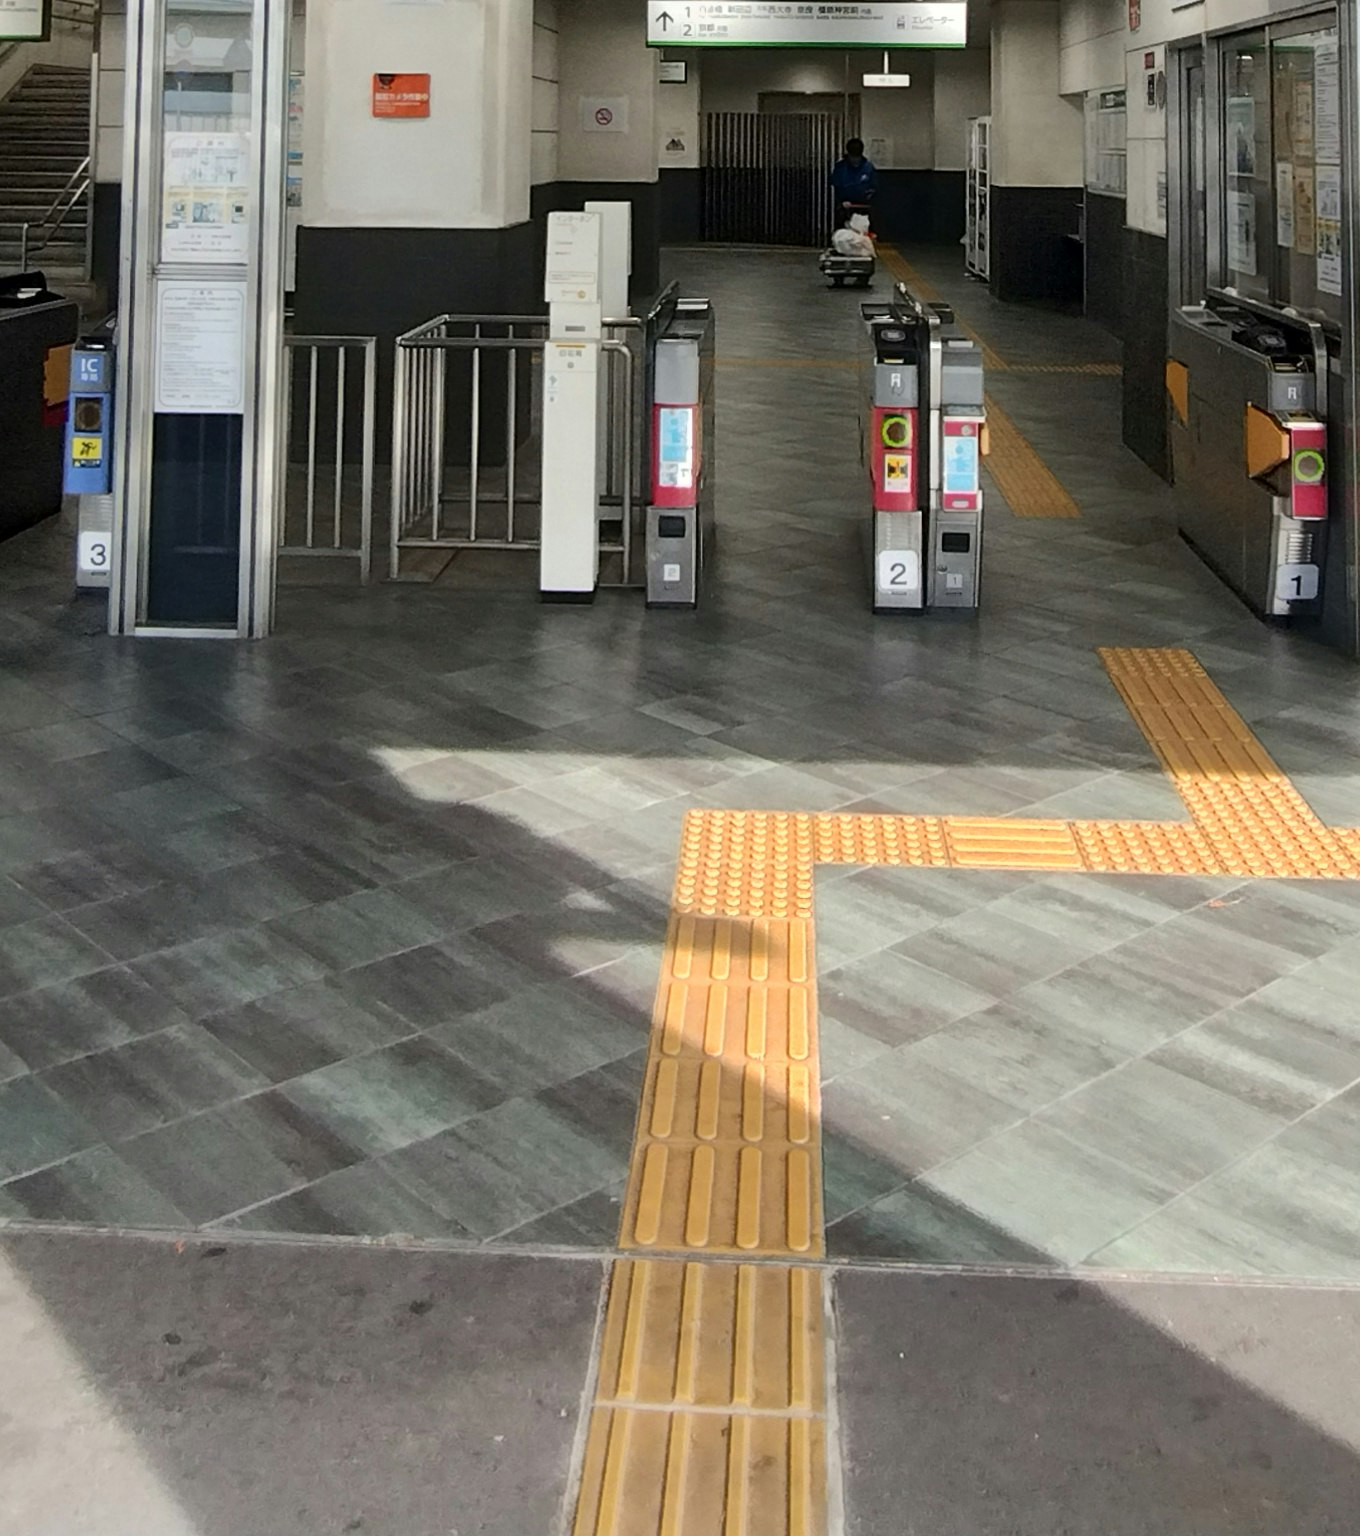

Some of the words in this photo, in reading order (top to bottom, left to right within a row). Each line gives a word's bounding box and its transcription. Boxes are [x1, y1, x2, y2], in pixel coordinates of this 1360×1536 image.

[685, 6, 691, 18] 1
[911, 16, 955, 24] エレベーター
[683, 24, 693, 37] 2
[81, 358, 99, 372] IC
[90, 544, 106, 565] 3
[890, 562, 907, 585] 2
[952, 576, 957, 585] 1
[1291, 575, 1302, 596] 1
